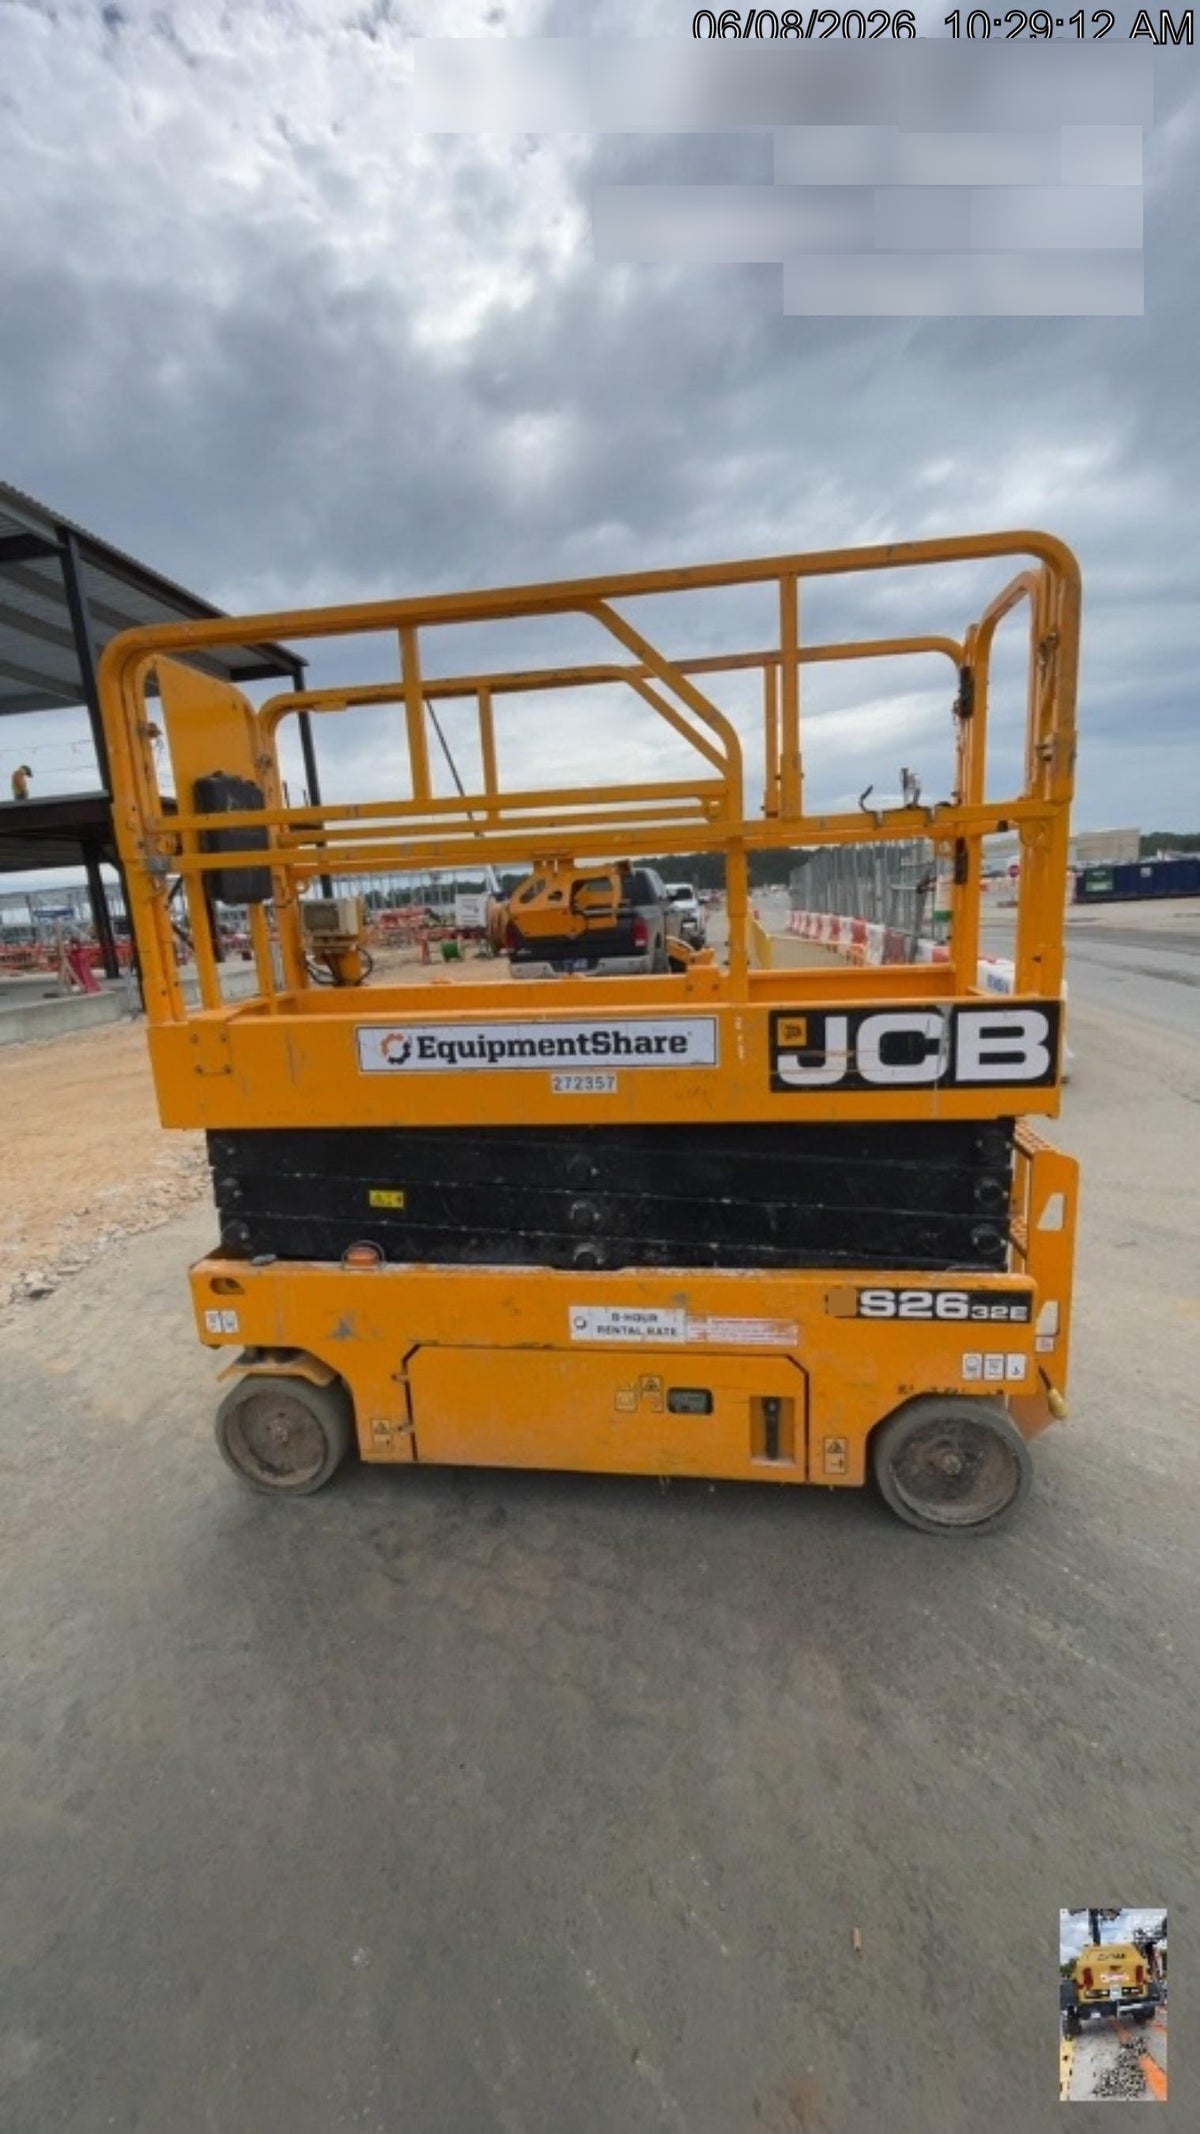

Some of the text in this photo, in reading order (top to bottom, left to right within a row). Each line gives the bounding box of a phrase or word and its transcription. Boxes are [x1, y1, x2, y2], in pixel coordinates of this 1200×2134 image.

[416, 1031, 688, 1063] EquipmentShare
[777, 1010, 1050, 1085] JCB
[554, 1076, 615, 1091] 272357
